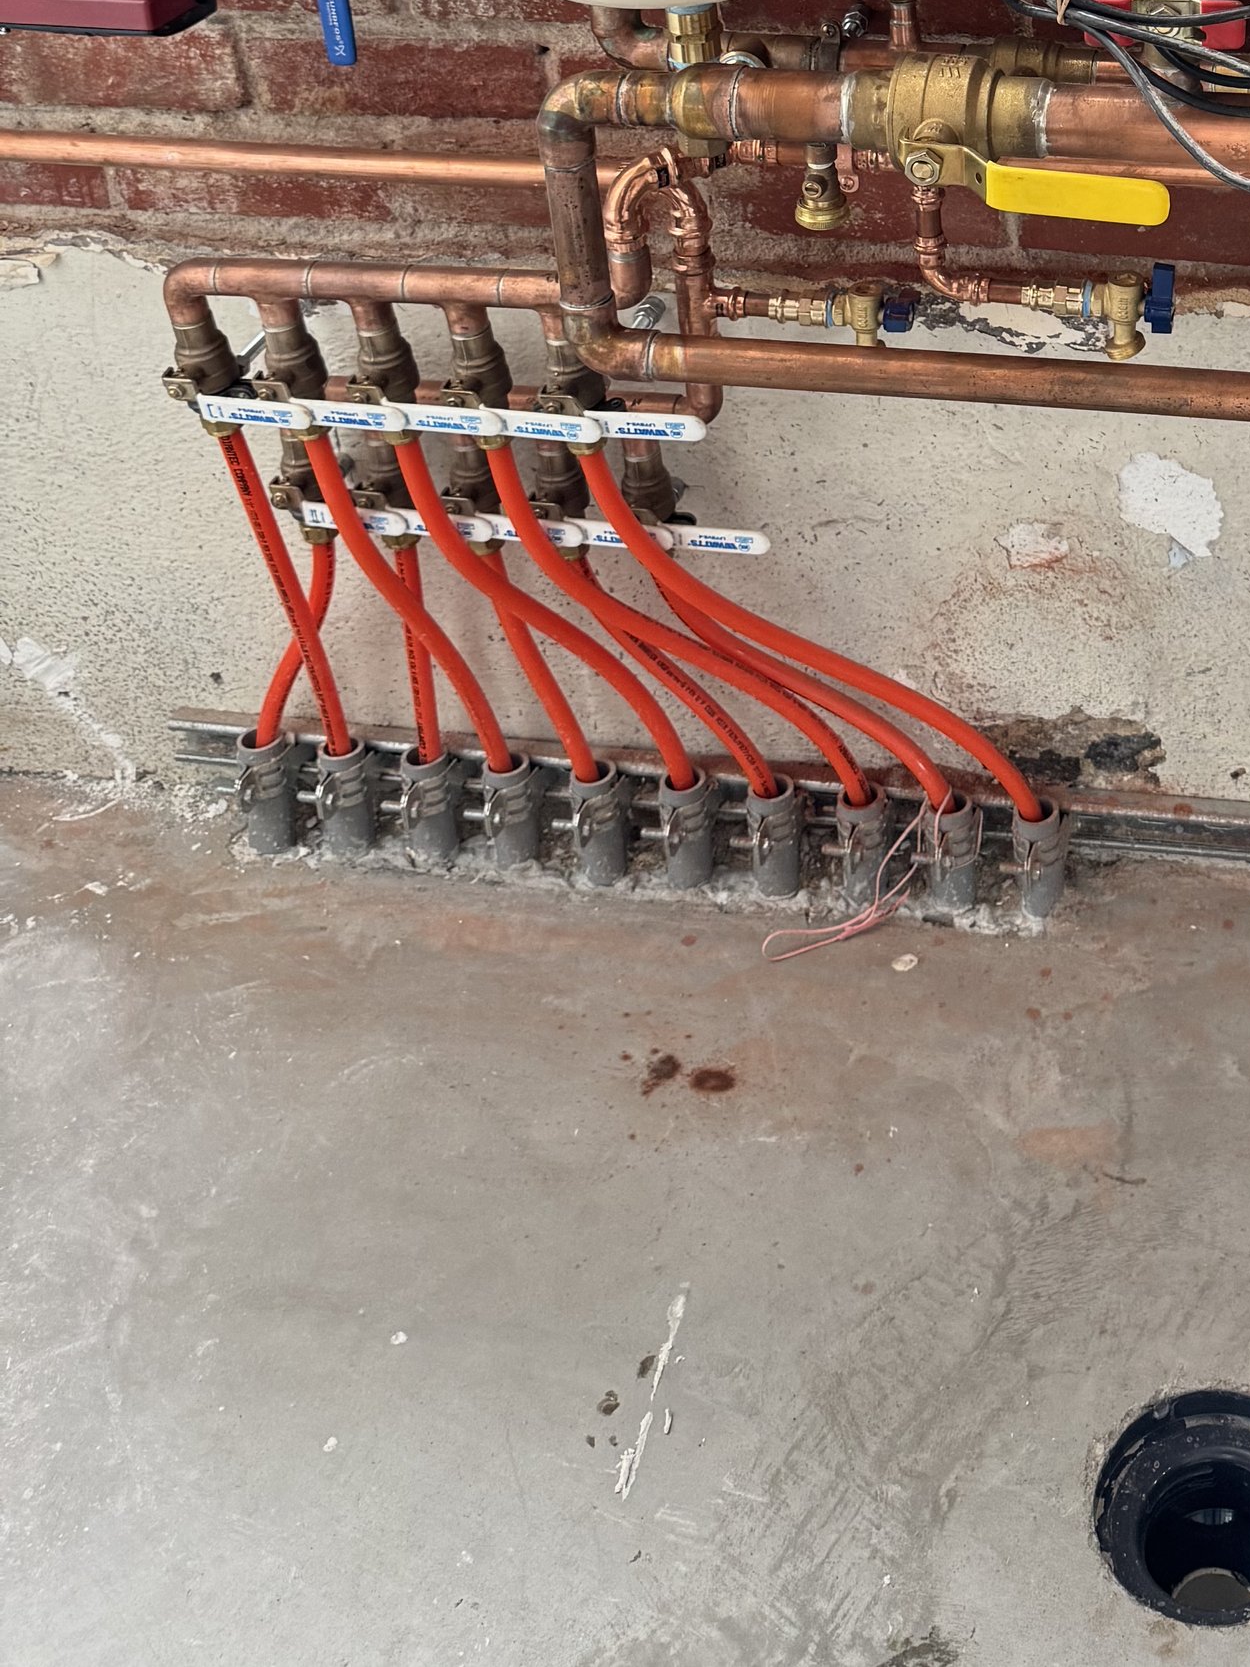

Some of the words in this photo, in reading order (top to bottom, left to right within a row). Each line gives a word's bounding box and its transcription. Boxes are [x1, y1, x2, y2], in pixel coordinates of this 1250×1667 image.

[229, 412, 266, 422] WATTS
[320, 415, 358, 425] WATTS
[416, 419, 453, 429] WATTS
[513, 426, 549, 436] WATTS
[615, 427, 653, 436] WATTS
[688, 539, 723, 550] WATTS
